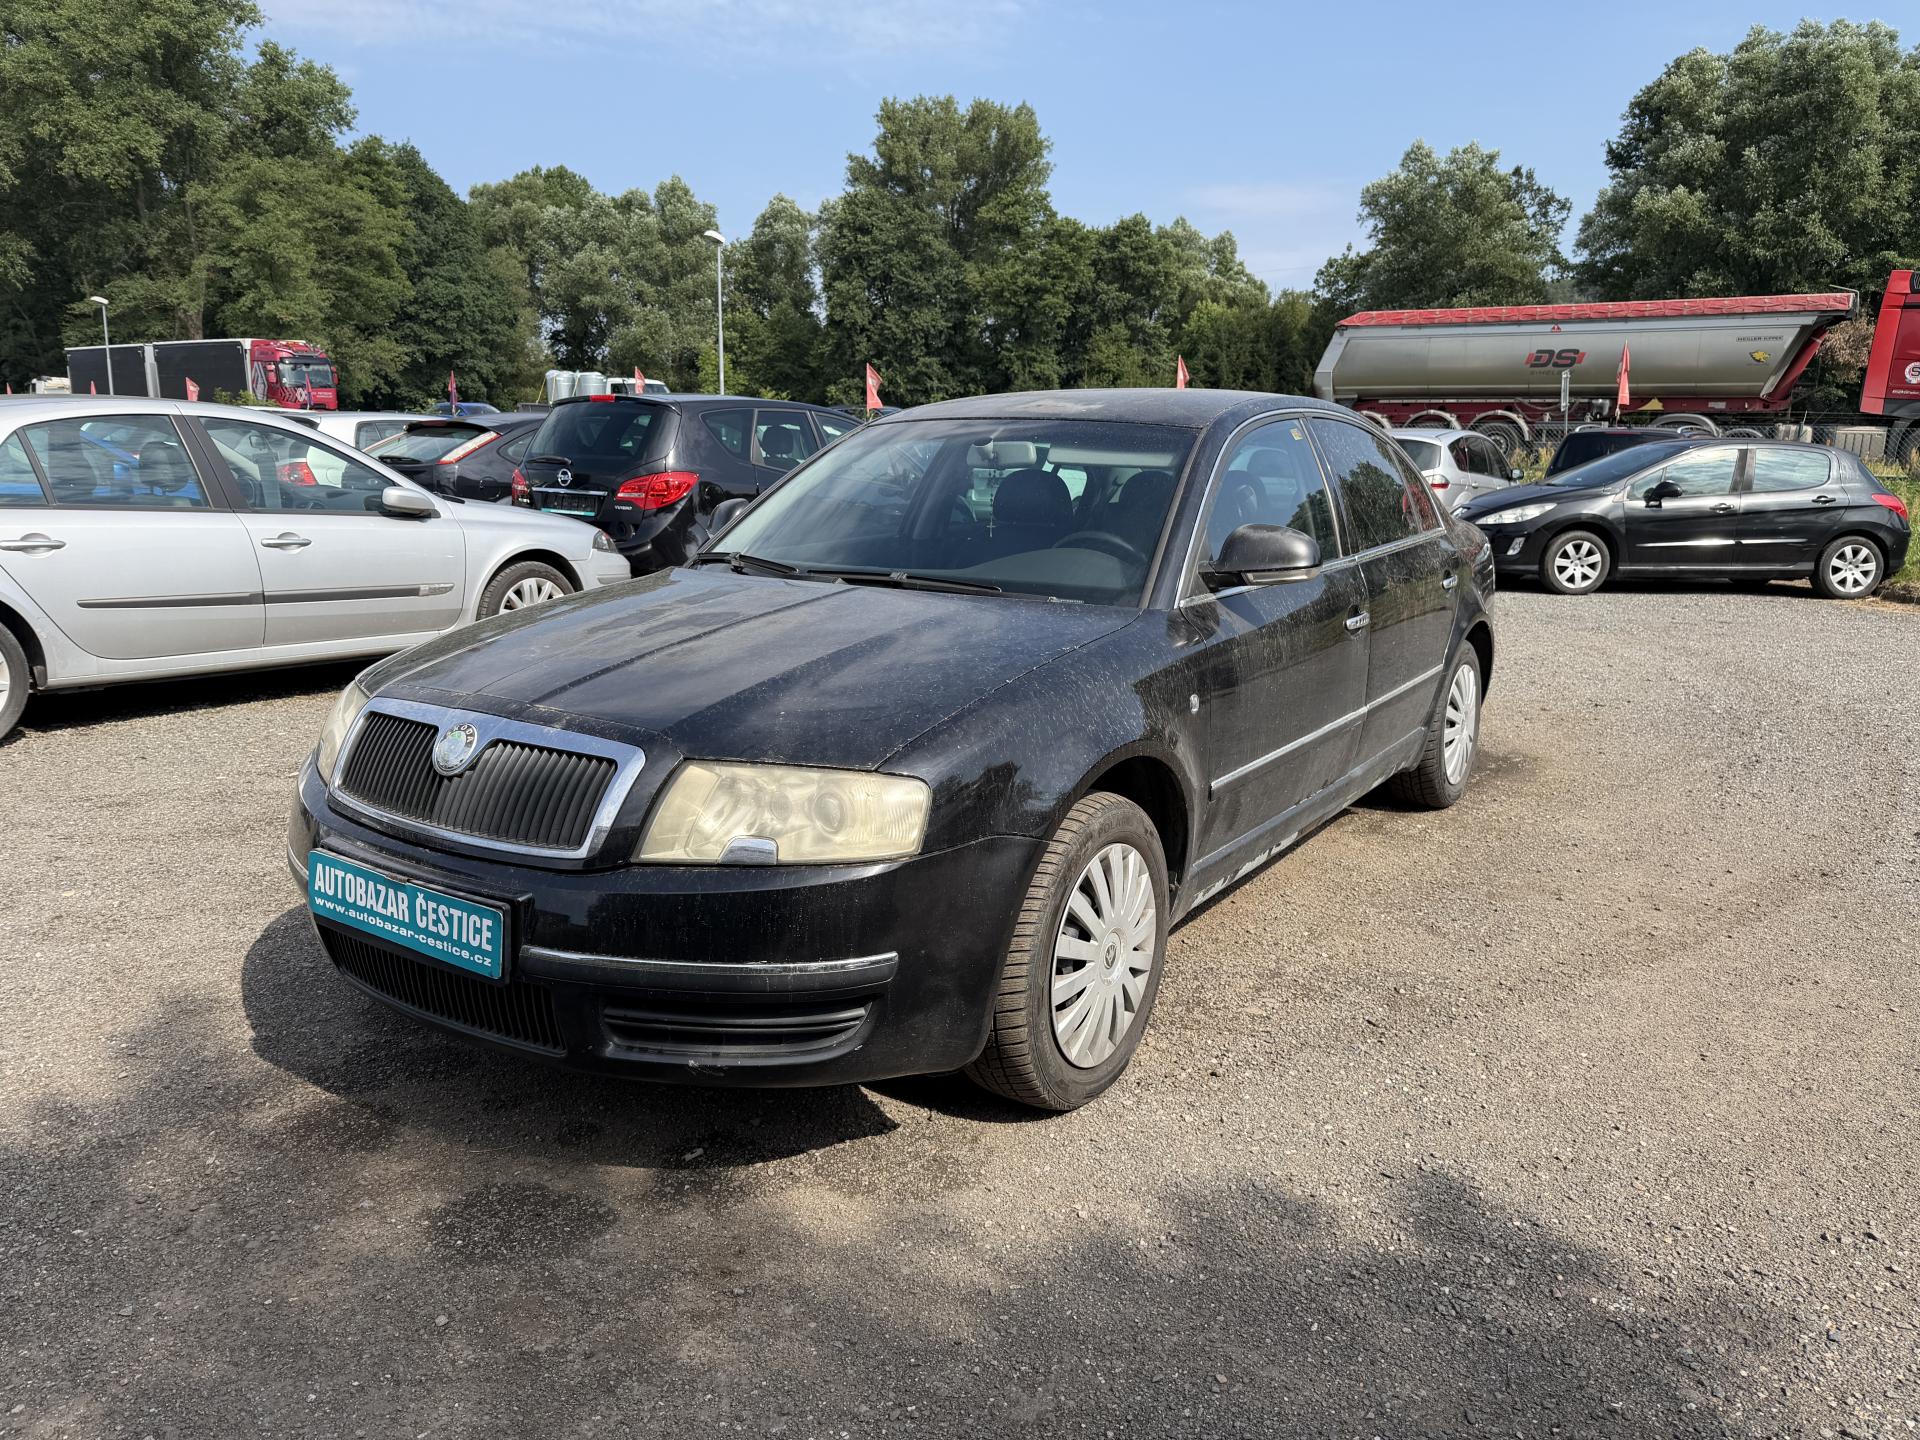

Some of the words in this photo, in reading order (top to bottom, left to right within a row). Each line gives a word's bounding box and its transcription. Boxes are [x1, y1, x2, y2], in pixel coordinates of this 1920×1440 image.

[314, 863, 410, 923] AUTOBAZAR
[415, 892, 493, 952] ČESTICE
[314, 896, 492, 967] www.autobazar-cestice.cz
